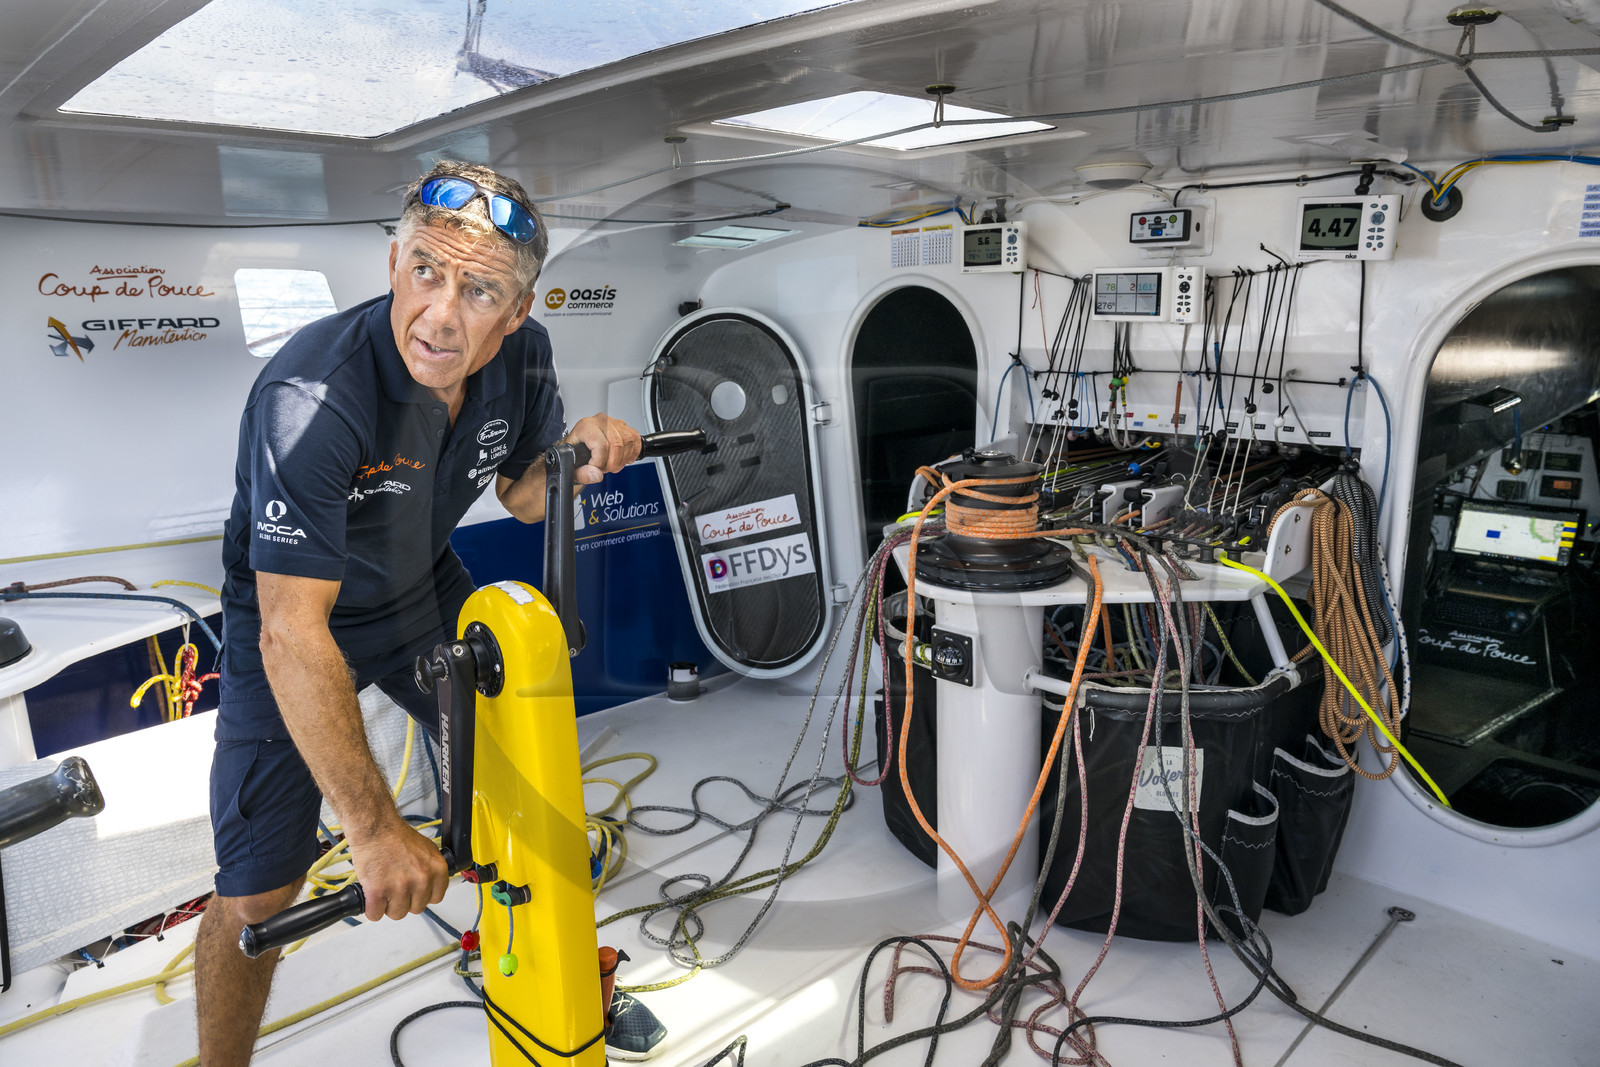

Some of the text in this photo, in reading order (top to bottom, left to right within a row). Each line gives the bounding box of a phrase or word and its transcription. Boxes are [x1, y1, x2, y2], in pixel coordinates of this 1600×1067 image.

[1308, 218, 1358, 237] 4.47
[978, 237, 990, 245] 5.6
[89, 265, 166, 275] Association
[38, 273, 215, 302] Coup de Pouce
[570, 284, 617, 301] oasis
[1106, 283, 1116, 291] 78
[81, 317, 220, 331] GIFFARD
[113, 328, 207, 351] Manutention
[591, 490, 623, 508] Web
[589, 502, 659, 525] & Solutions
[726, 507, 765, 520] Association
[257, 521, 307, 538] IMOCA
[702, 513, 794, 539] Coup de Pouce
[272, 536, 299, 545] SERIES
[580, 543, 590, 551] en
[591, 536, 625, 549] commerce
[626, 527, 660, 541] omnicanal
[1459, 643, 1481, 654] de
[1483, 644, 1537, 664] Pouce
[441, 713, 450, 795] HARKEN
